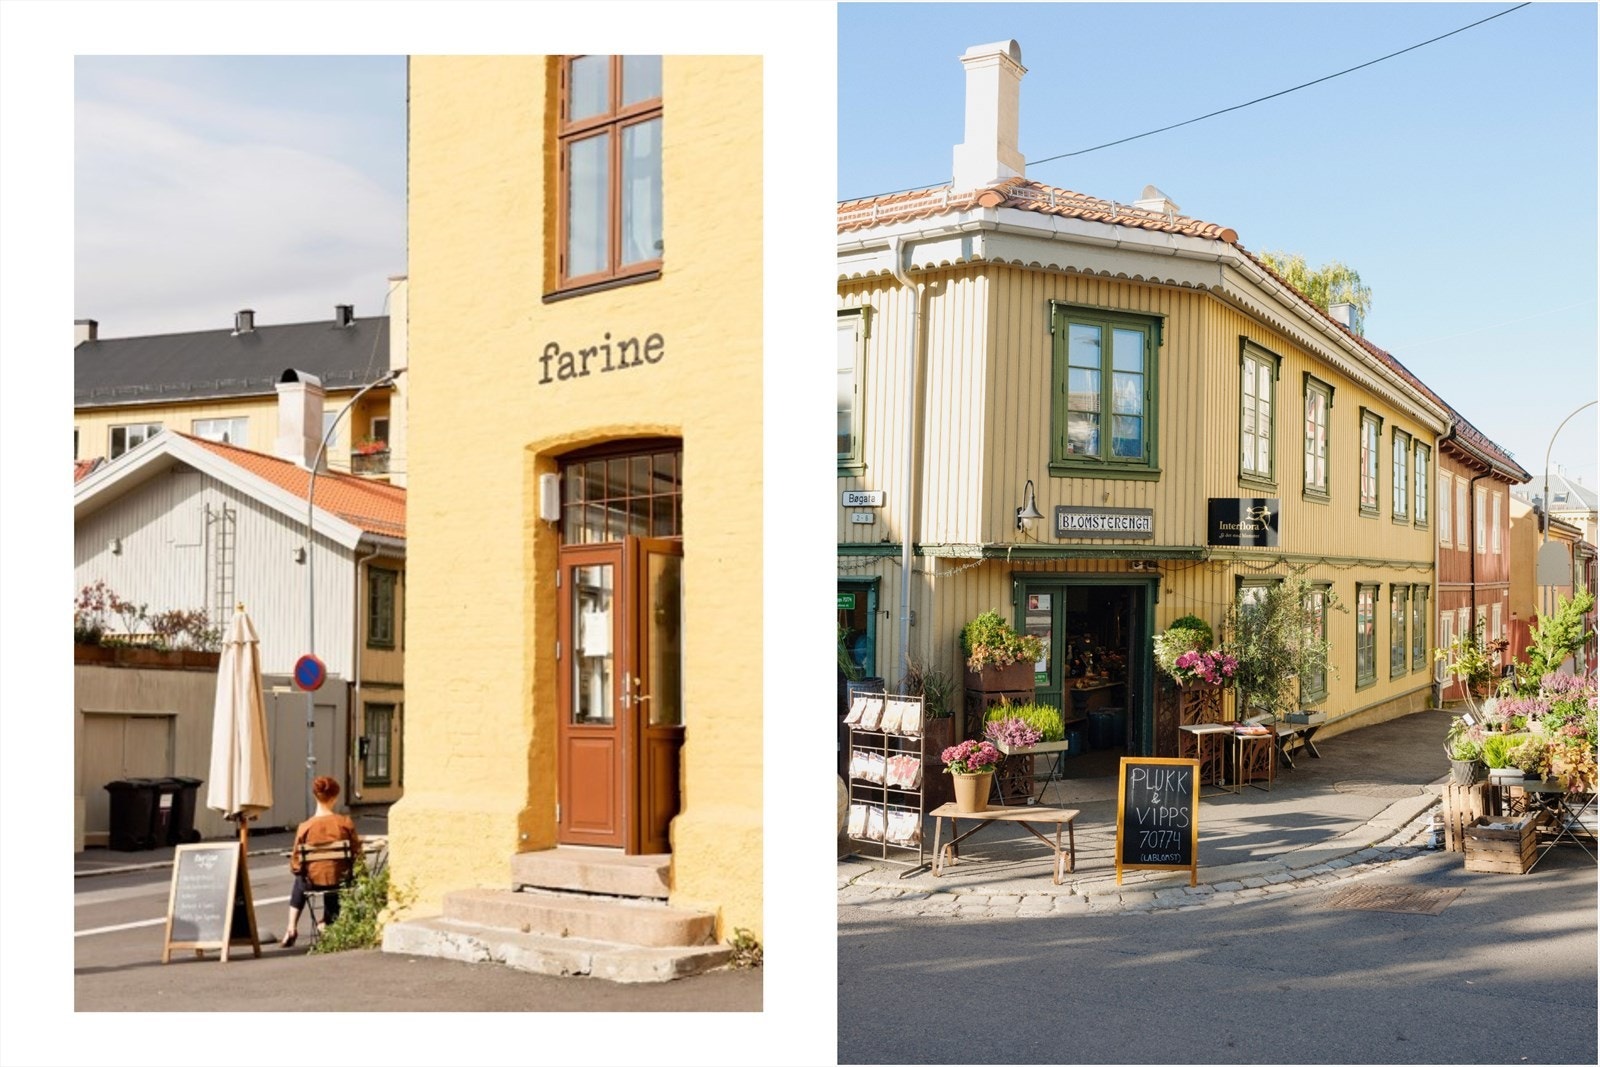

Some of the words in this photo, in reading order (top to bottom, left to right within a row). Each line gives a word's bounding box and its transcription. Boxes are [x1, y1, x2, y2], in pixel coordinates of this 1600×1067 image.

[539, 332, 664, 384] farine
[849, 494, 876, 504] Bøgata
[1062, 515, 1150, 530] BLOMSTERENGA
[1219, 520, 1260, 531] Interflora
[1131, 768, 1188, 794] PLUKK
[1151, 792, 1160, 804] &
[1136, 806, 1189, 828] VIPPS
[1140, 831, 1181, 850] 70774
